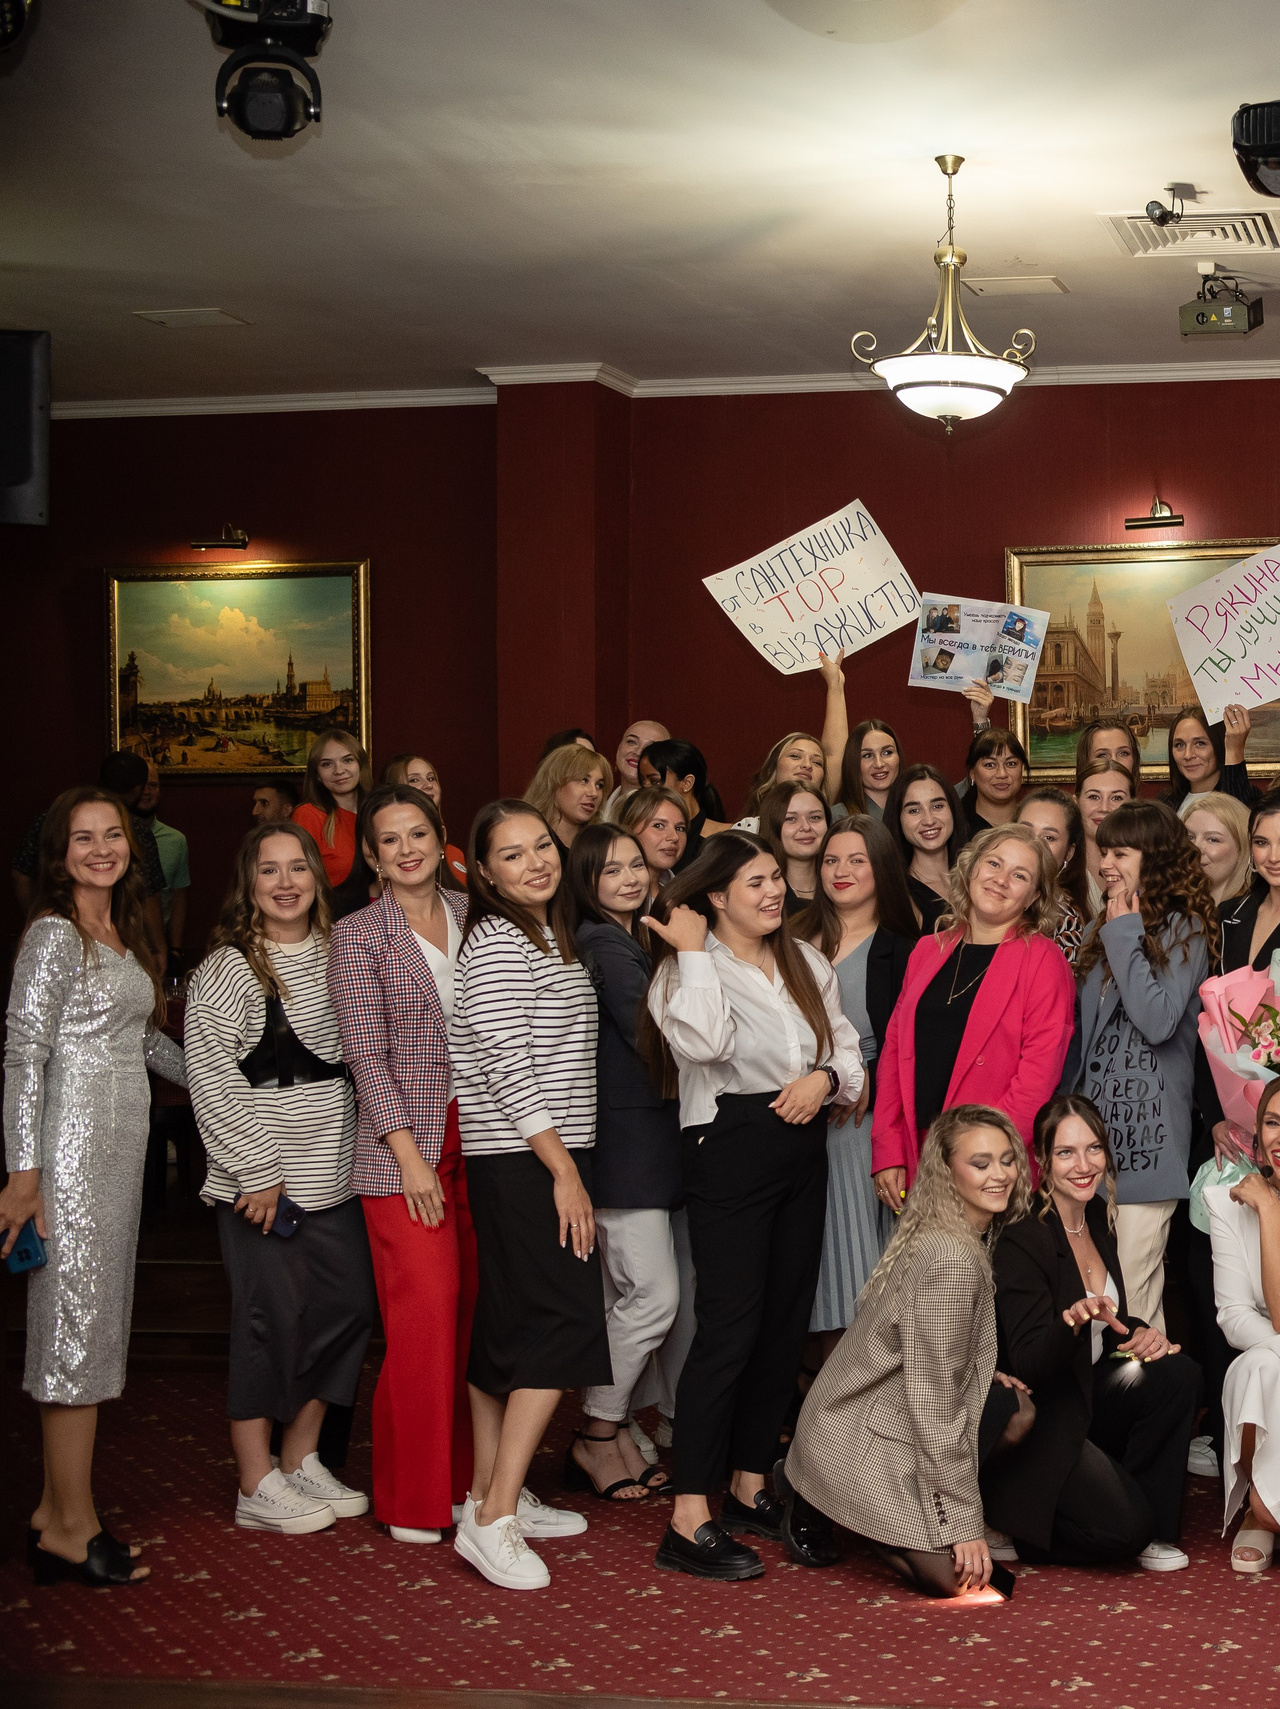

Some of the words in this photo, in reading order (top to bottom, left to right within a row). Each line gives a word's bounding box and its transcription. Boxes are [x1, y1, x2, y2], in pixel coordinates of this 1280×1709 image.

[735, 511, 877, 605] САНТЕХНИКА
[763, 572, 921, 669] ВИЗАЖИСТЫ
[920, 634, 937, 645] Мы
[938, 638, 970, 651] всегда
[980, 644, 997, 653] тебя
[1193, 648, 1236, 683] ТЫ
[1112, 1078, 1150, 1100] RED
